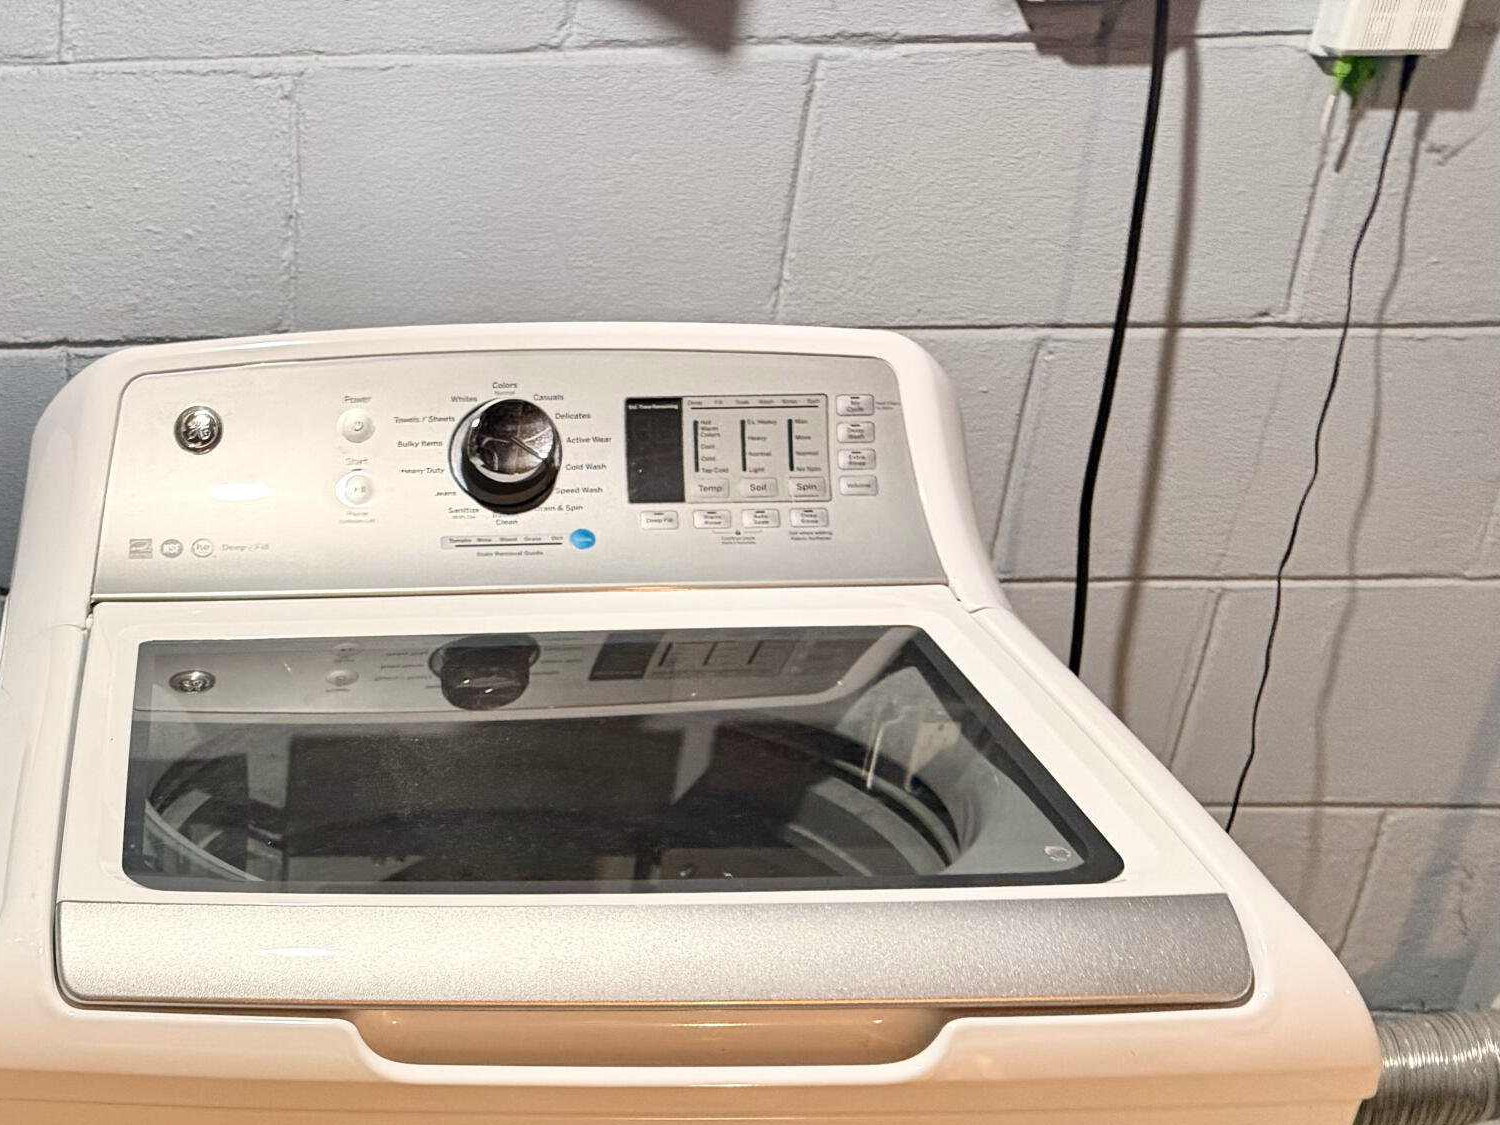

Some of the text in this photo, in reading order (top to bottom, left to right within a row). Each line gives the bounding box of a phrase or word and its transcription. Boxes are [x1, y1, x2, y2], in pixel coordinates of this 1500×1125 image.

[492, 381, 518, 389] Colors
[450, 395, 478, 403] Whites
[533, 393, 565, 401] Casuals
[555, 412, 592, 420] Delicates
[566, 436, 591, 444] Active
[565, 463, 608, 471] Cold Wash
[582, 486, 604, 494] Wash
[697, 483, 724, 494] Temp
[749, 482, 768, 492] Soil
[796, 481, 819, 492] Spin
[565, 503, 584, 513] Spin
[494, 518, 519, 527] Clean
